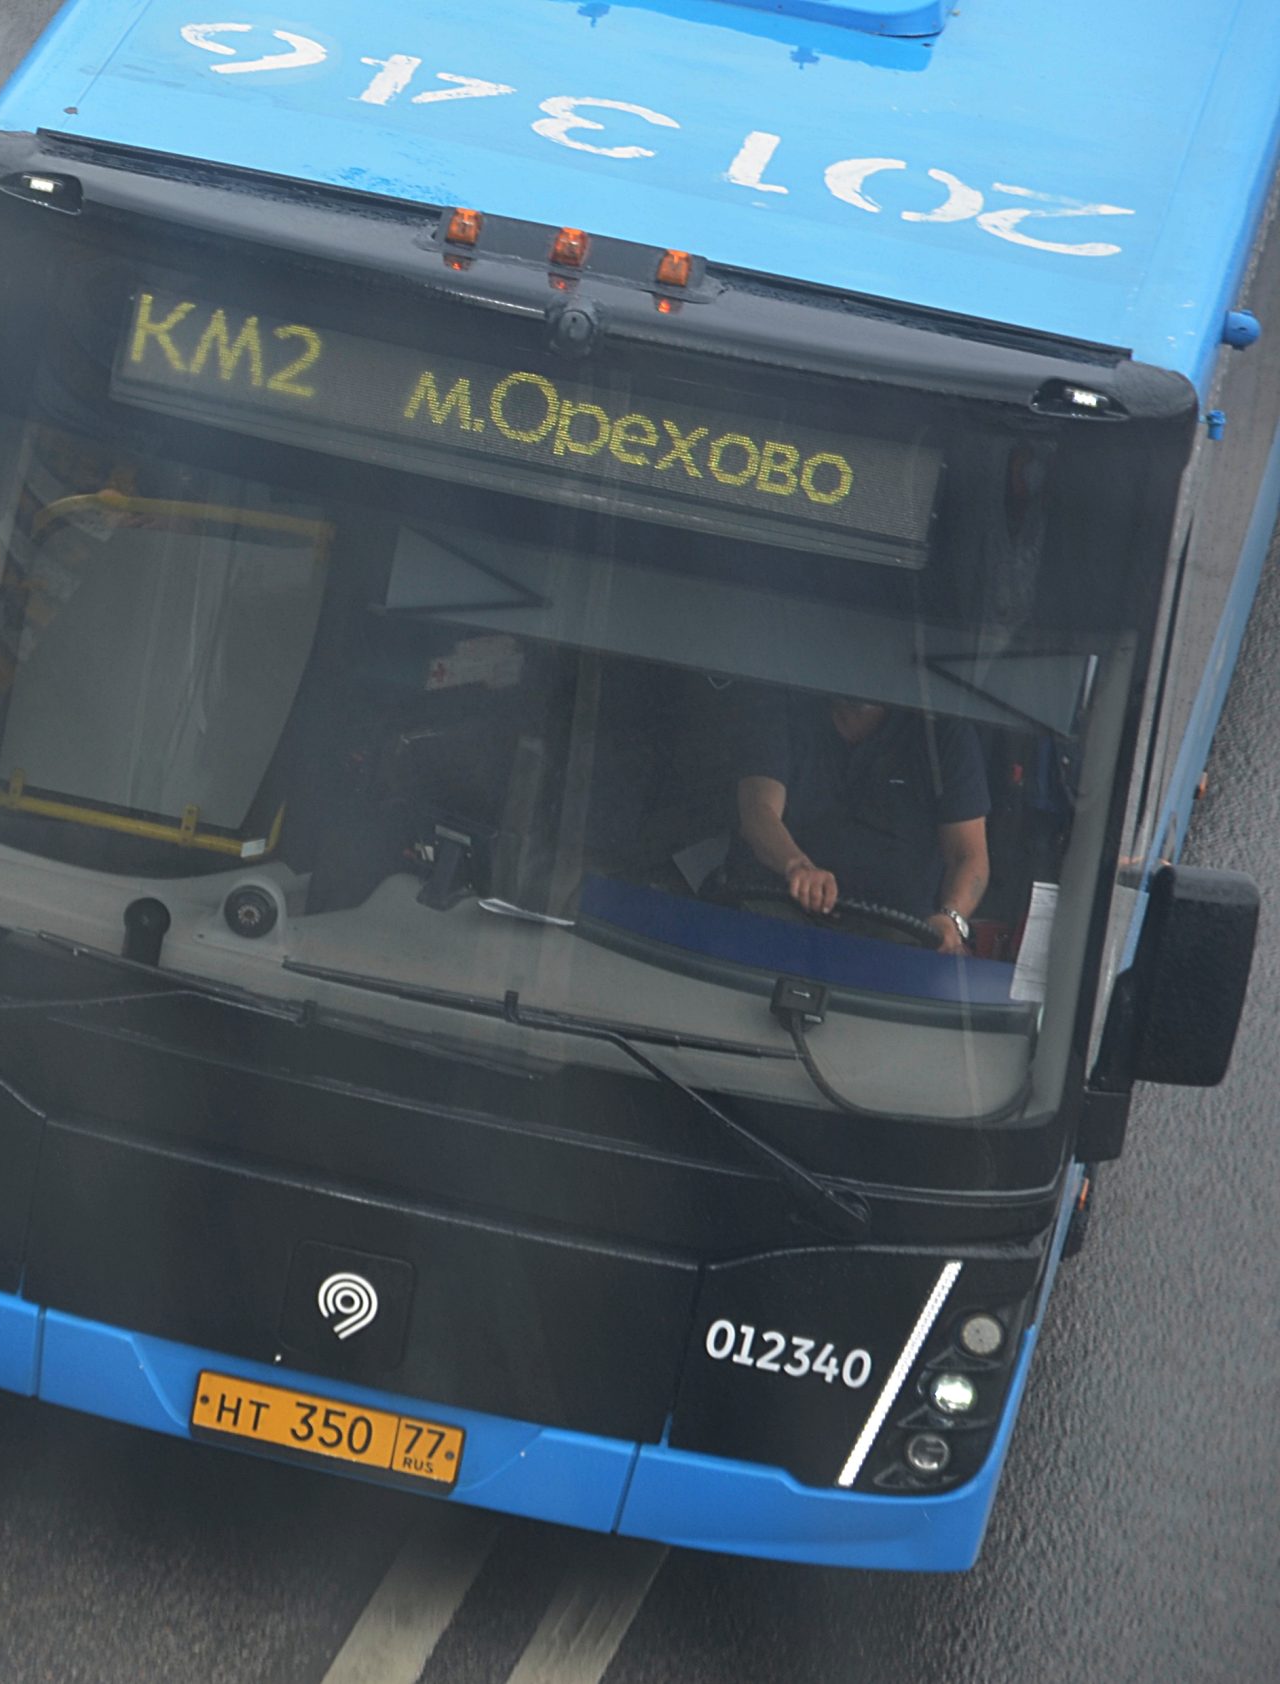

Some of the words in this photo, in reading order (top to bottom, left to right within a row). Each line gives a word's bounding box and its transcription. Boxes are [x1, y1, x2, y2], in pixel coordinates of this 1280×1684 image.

[129, 293, 320, 397] КМ2
[705, 1319, 872, 1388] 012340
[290, 1401, 373, 1454] 350
[404, 1423, 445, 1459] 77
[403, 1456, 434, 1474] RUS
